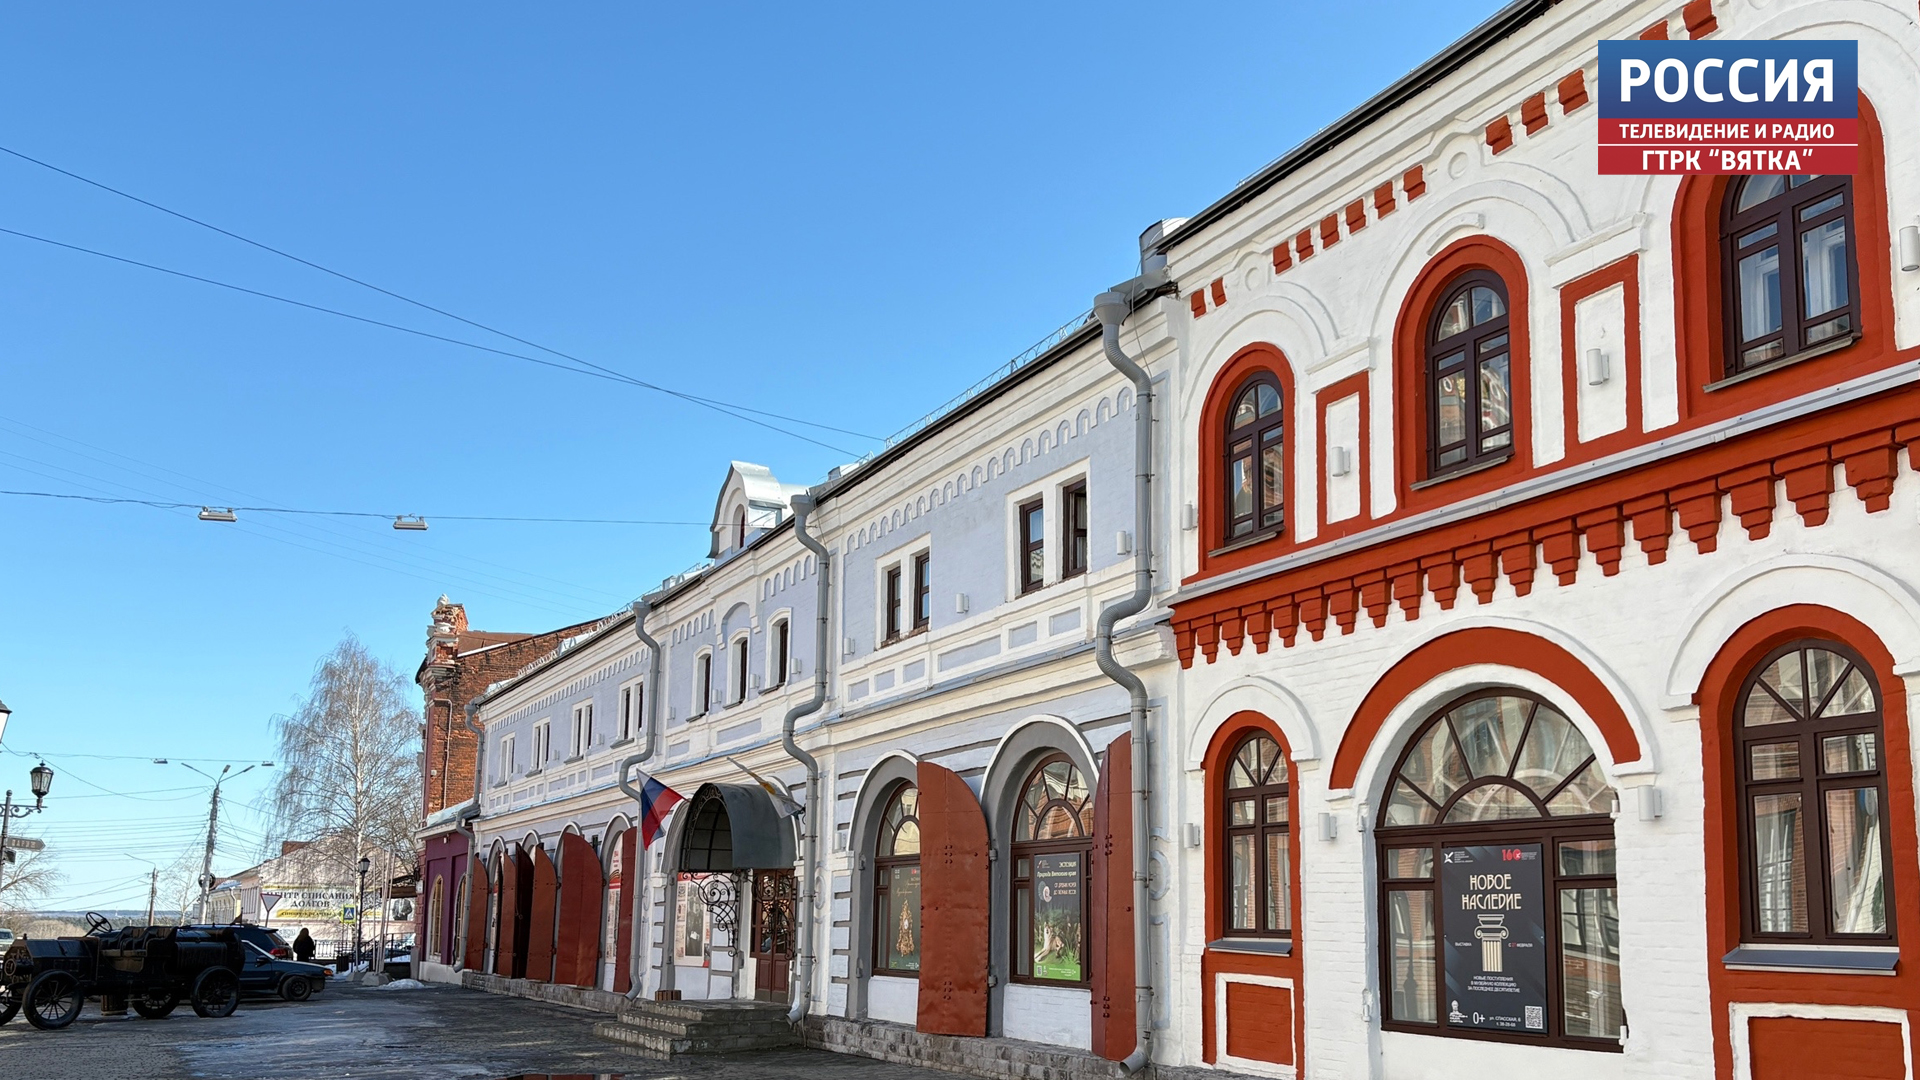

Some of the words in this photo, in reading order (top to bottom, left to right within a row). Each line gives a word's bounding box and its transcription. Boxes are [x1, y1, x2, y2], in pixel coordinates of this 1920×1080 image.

[1502, 848, 1522, 862] 160
[1470, 874, 1512, 890] НОВОЕ
[301, 891, 354, 900] СПИСАНИЯ
[1462, 893, 1522, 911] НАСЛЕДИЕ
[1473, 1012, 1485, 1024] 0+
